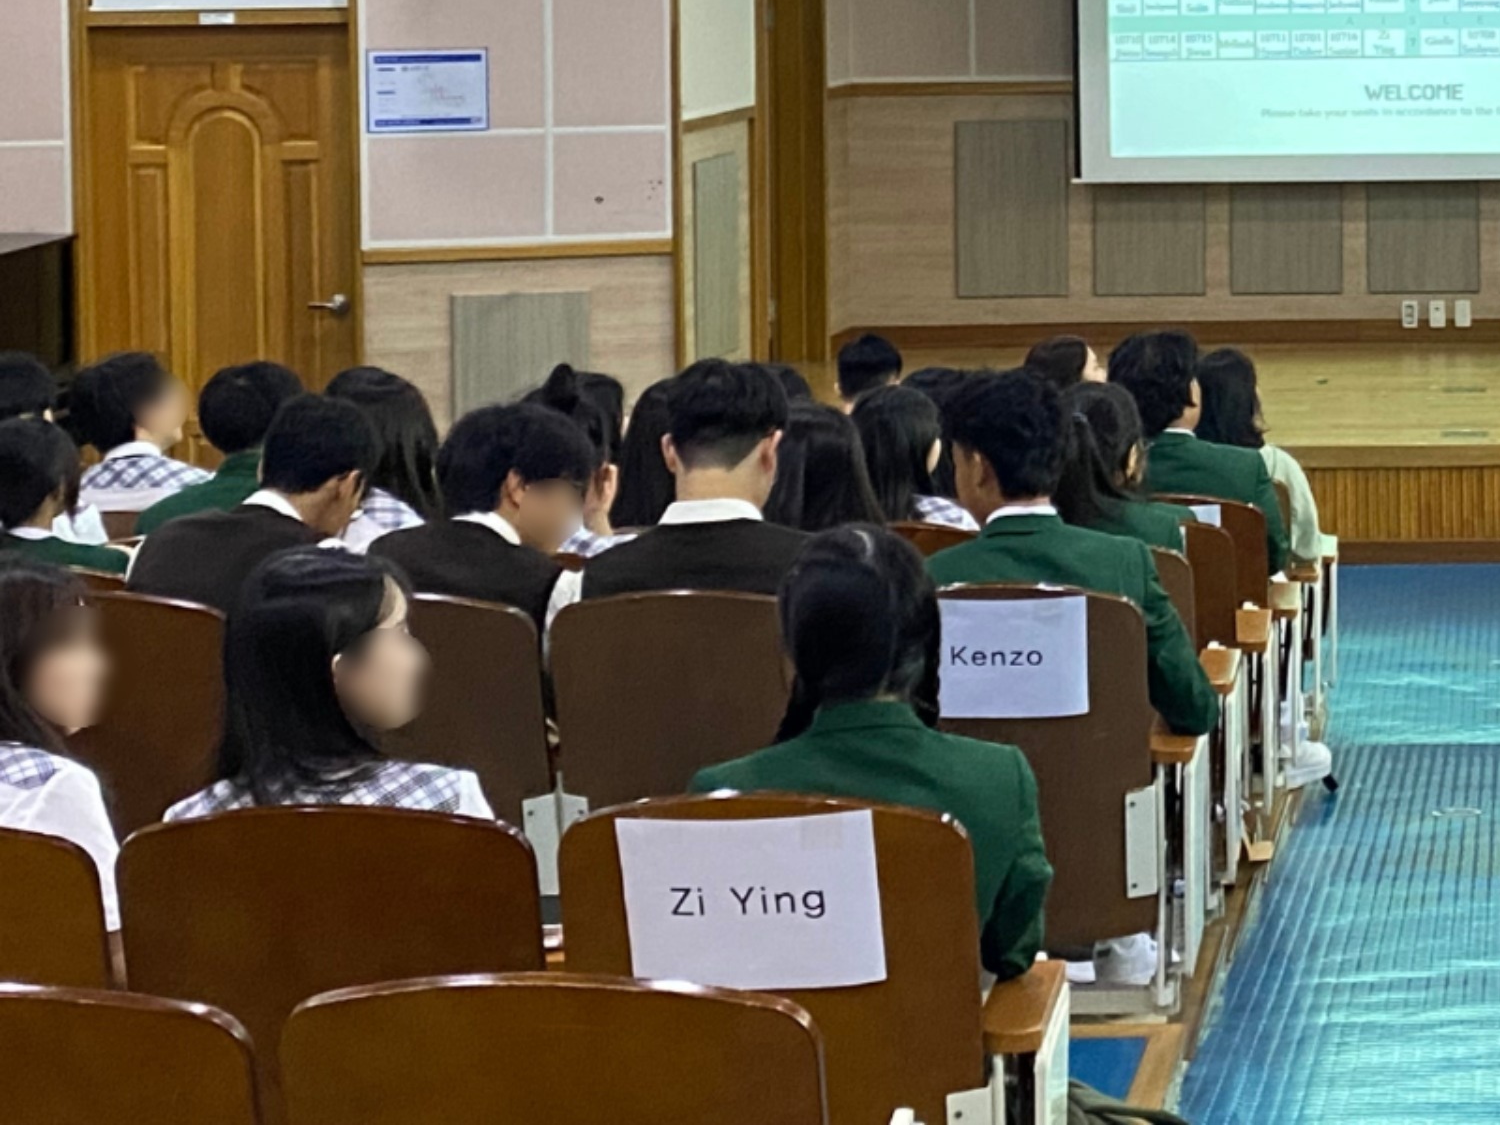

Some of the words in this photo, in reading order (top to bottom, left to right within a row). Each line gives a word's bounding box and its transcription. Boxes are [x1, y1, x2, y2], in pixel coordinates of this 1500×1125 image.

[1364, 84, 1464, 101] WELCOME
[1261, 108, 1296, 118] Please
[1299, 109, 1321, 118] take
[1324, 110, 1347, 120] your
[1382, 108, 1393, 117] in
[1395, 107, 1458, 117] accordance
[1460, 107, 1472, 116] to
[1475, 106, 1493, 116] the
[950, 646, 1043, 667] Kenzo
[669, 887, 705, 917] Zi
[729, 886, 827, 920] Ying
